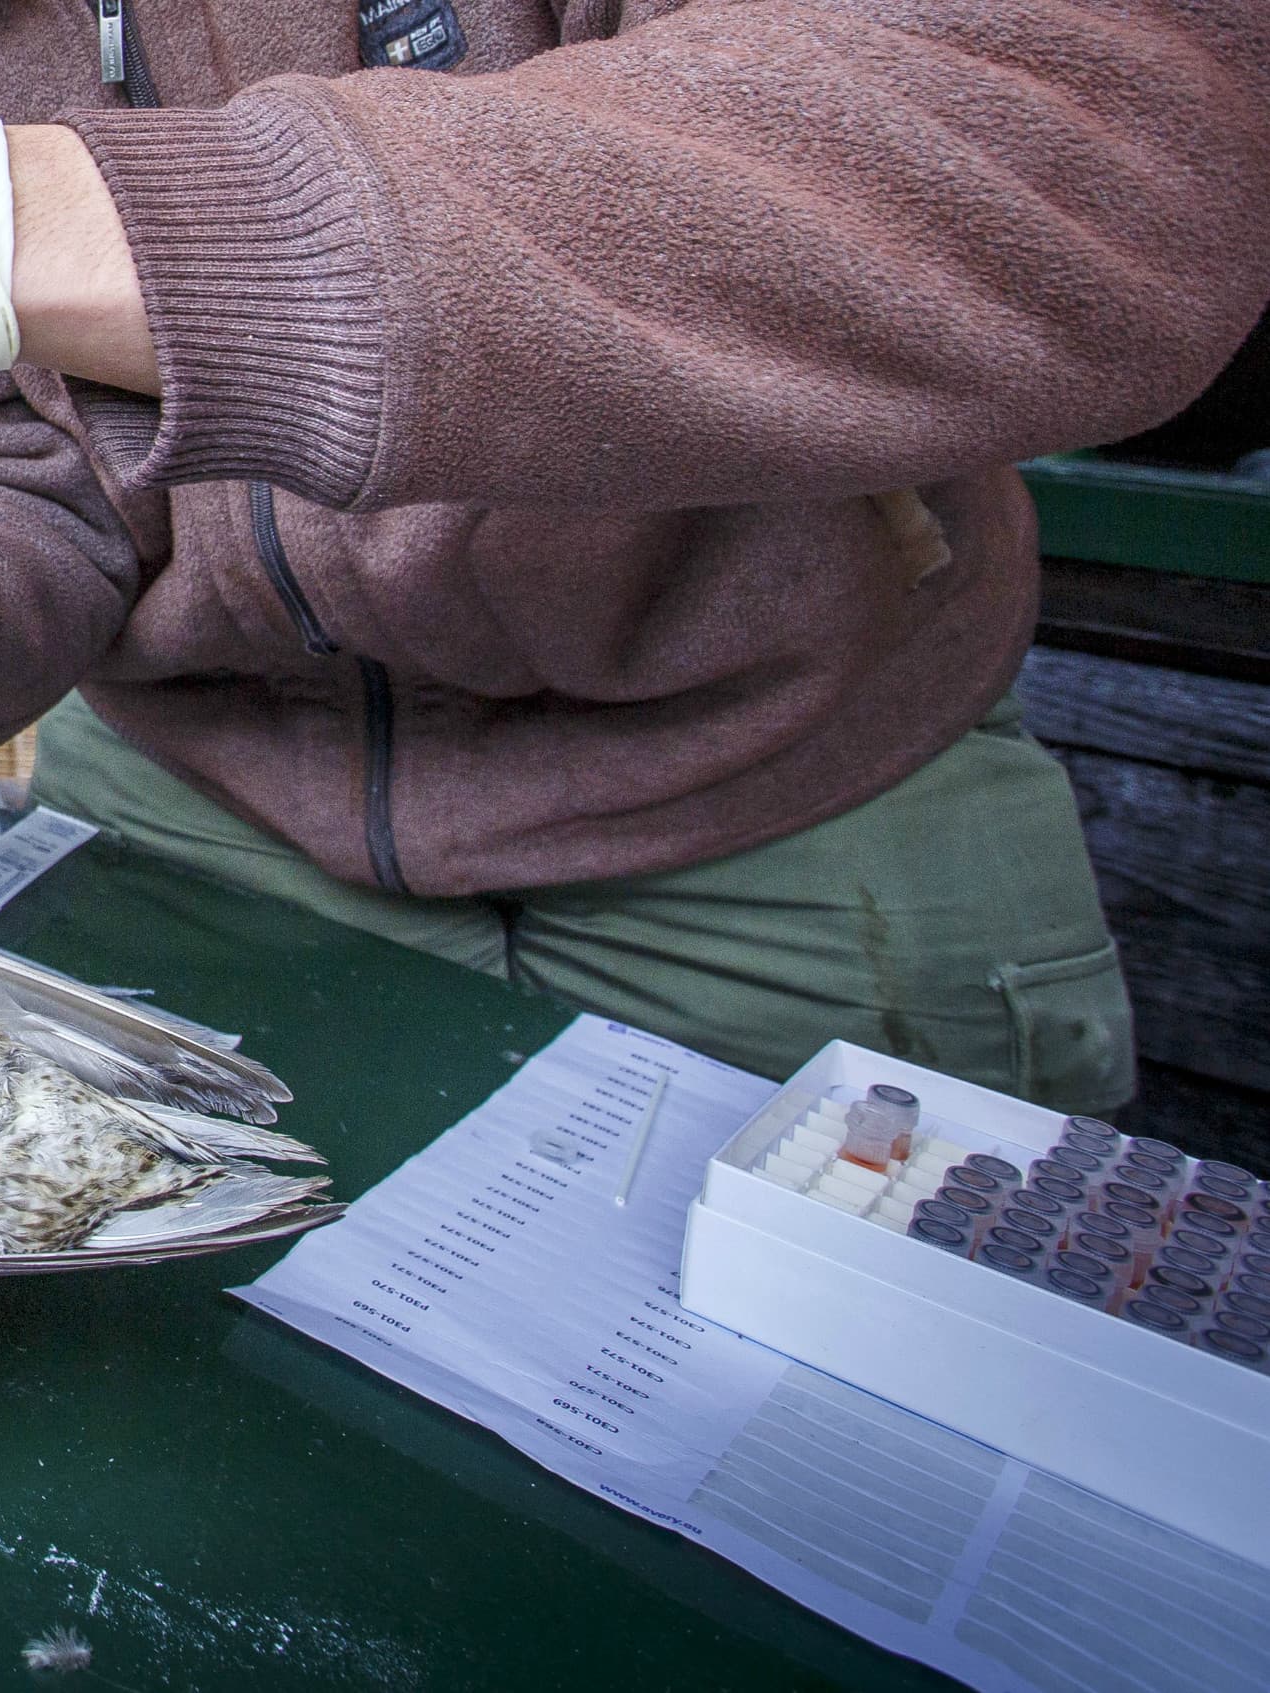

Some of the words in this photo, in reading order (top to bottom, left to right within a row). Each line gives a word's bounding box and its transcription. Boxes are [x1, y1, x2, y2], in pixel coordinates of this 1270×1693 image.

[371, 1278, 430, 1311] P301-570
[390, 1262, 446, 1294] P301-571
[352, 1300, 410, 1332] P301-569
[630, 1316, 692, 1350] C301-574
[644, 1301, 705, 1332] C301-575
[600, 1347, 664, 1383] C301-572
[616, 1330, 678, 1366] C301-573
[569, 1380, 634, 1414] C301-570
[586, 1364, 650, 1399] C301-571
[552, 1398, 618, 1434] C301-569
